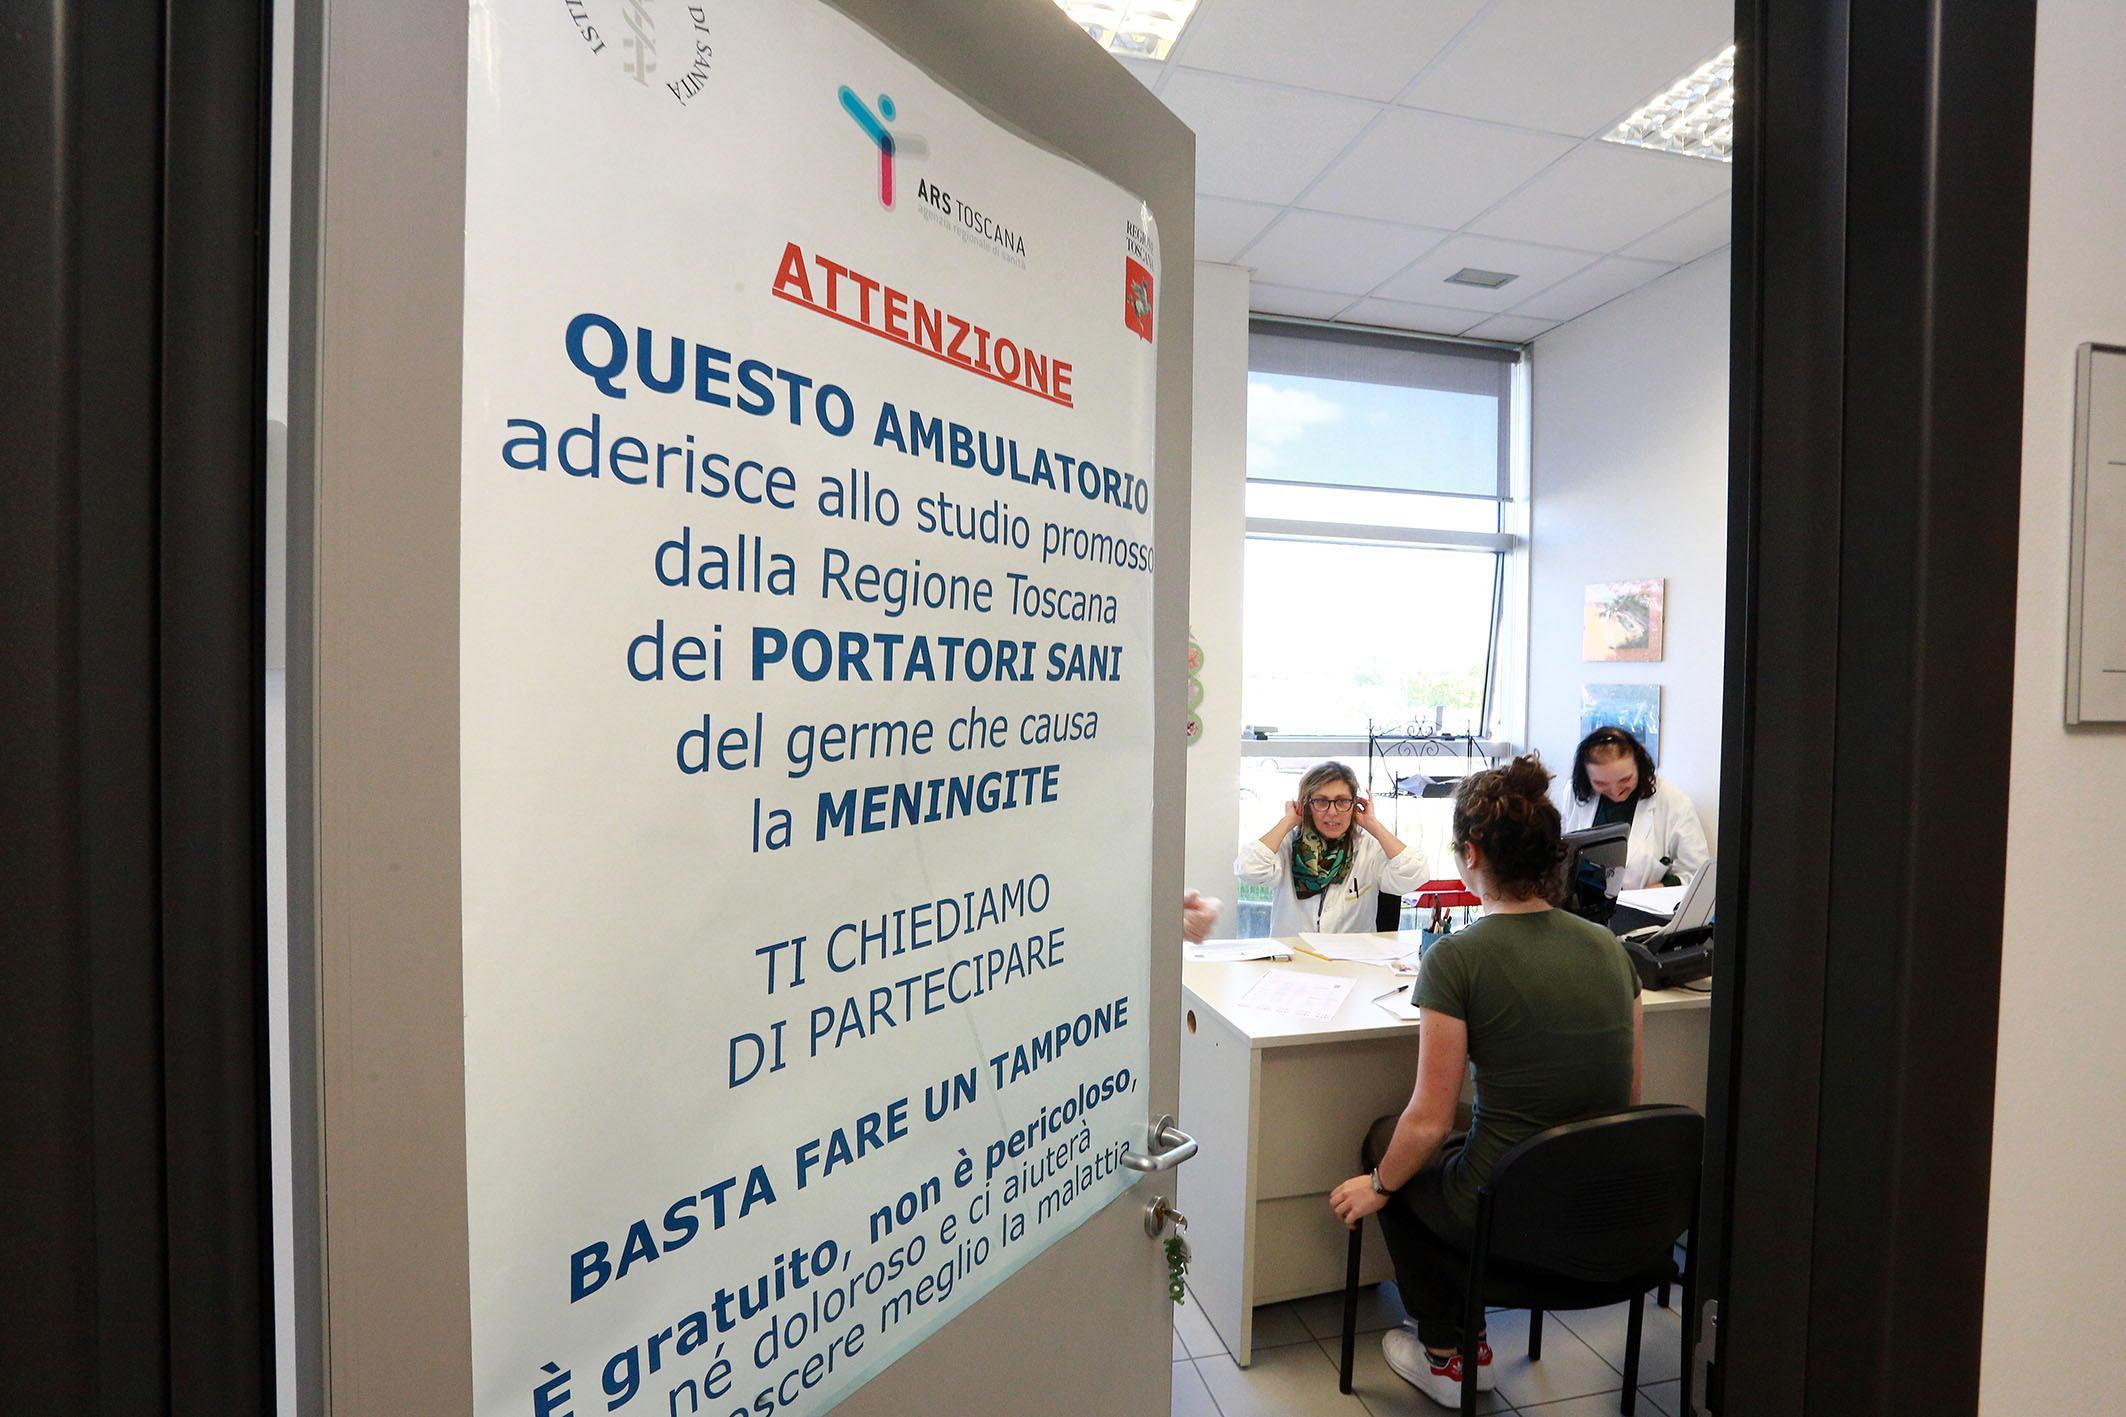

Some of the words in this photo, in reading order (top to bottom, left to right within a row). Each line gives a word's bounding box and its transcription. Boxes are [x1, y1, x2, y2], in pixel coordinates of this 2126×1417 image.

[688, 6, 710, 35] DI
[918, 178, 951, 215] ARS
[956, 200, 1026, 257] TOSCANA
[774, 242, 1073, 402] ATTENZIONE
[565, 313, 855, 438] QUESTO
[873, 402, 1149, 515] AMBULATORIO
[502, 413, 796, 509] aderisce
[817, 467, 901, 527] allo
[916, 490, 1031, 551] studio
[1043, 521, 1154, 575] promosso
[655, 526, 796, 597] dalla
[821, 548, 993, 618] Regione
[1006, 573, 1118, 625] Toscana
[626, 619, 722, 683] dei
[751, 626, 1036, 683] PORTATORI
[1046, 642, 1122, 682] SANI
[675, 712, 763, 775] del
[786, 717, 934, 779] germe
[947, 706, 1008, 752] che
[1018, 710, 1099, 746] causa
[752, 798, 793, 854] la
[815, 764, 1060, 842] MENINGITE
[755, 936, 807, 996] TI
[825, 873, 1051, 975] CHIEDIAMO
[728, 1020, 788, 1089] DI
[809, 926, 1066, 1058] PARTECIPARE
[570, 1164, 777, 1305] BASTA
[797, 1098, 909, 1190] FARE
[924, 1066, 978, 1123] UN
[989, 996, 1129, 1092] TAMPONE
[533, 1360, 576, 1417] È
[601, 1238, 852, 1414] gratuito,
[868, 1172, 941, 1245] non
[953, 1149, 975, 1188] è
[986, 1068, 1137, 1177] pericoloso,
[669, 1341, 732, 1417] né
[753, 1231, 927, 1370] doloroso
[939, 1213, 957, 1246] e
[968, 1180, 992, 1233] ci
[1003, 1119, 1091, 1205] aiuterà
[880, 1236, 990, 1332] meglio
[1002, 1213, 1025, 1249] la
